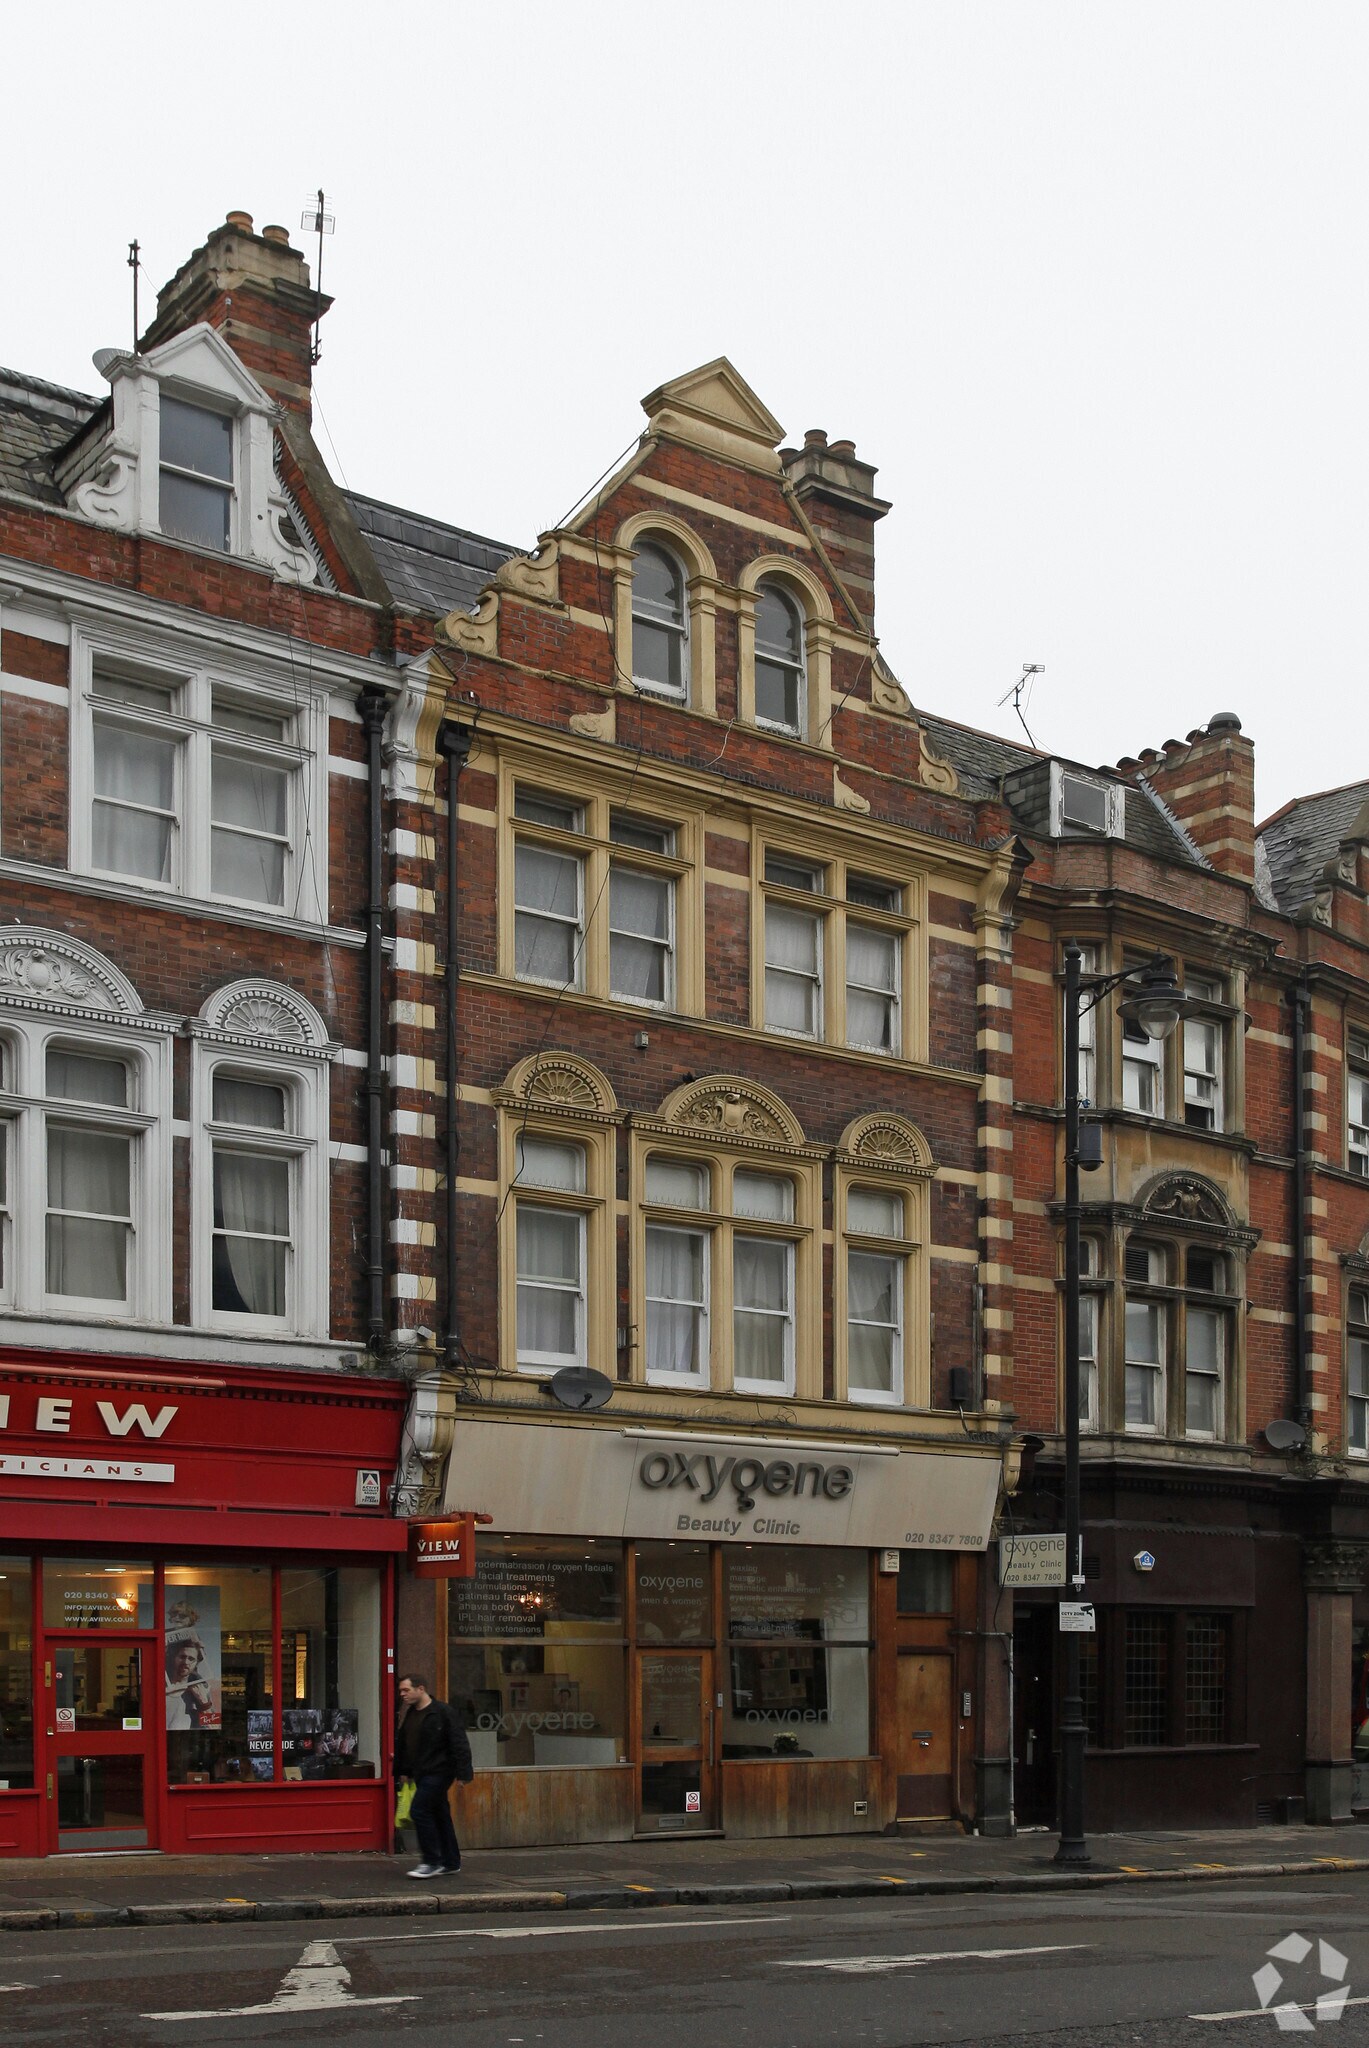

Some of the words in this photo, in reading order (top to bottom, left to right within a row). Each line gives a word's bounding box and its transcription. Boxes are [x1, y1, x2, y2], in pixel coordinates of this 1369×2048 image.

[640, 1452, 853, 1512] oxygene
[677, 1515, 741, 1536] Beauty
[753, 1519, 800, 1535] Clinic
[905, 1532, 924, 1544] 020
[929, 1533, 954, 1545] 8347
[959, 1535, 983, 1546] 7800
[417, 1540, 459, 1552] VIEW
[1005, 1540, 1065, 1558] oxygene
[474, 1561, 545, 1570] rodermabrasion
[552, 1564, 582, 1573] oxygen
[585, 1563, 613, 1572] facials
[730, 1564, 758, 1573] waxing
[478, 1571, 504, 1581] facial
[506, 1572, 556, 1582] treatments
[1045, 1573, 1062, 1581] 7800
[458, 1582, 473, 1591] md
[474, 1581, 527, 1591] formulations
[640, 1576, 704, 1593] oxygene
[730, 1583, 765, 1592] cosmetic
[767, 1584, 821, 1594] enhancement
[64, 1591, 82, 1599] 020
[85, 1591, 108, 1599] 8340
[458, 1592, 500, 1602] gatineau
[503, 1593, 534, 1601] facials
[662, 1597, 669, 1605] &
[64, 1604, 135, 1612] INFO@AVIEW.COUK
[458, 1603, 488, 1611] ahava
[491, 1603, 515, 1613] body
[458, 1614, 474, 1622] IPL
[477, 1614, 496, 1622] hair
[498, 1614, 536, 1622] removal
[458, 1625, 493, 1634] eyelash
[495, 1625, 541, 1633] extensions
[919, 1664, 925, 1672] 4
[477, 1711, 595, 1736] oxygene
[249, 1740, 274, 1750] NEVER
[281, 1740, 295, 1750] IDE
